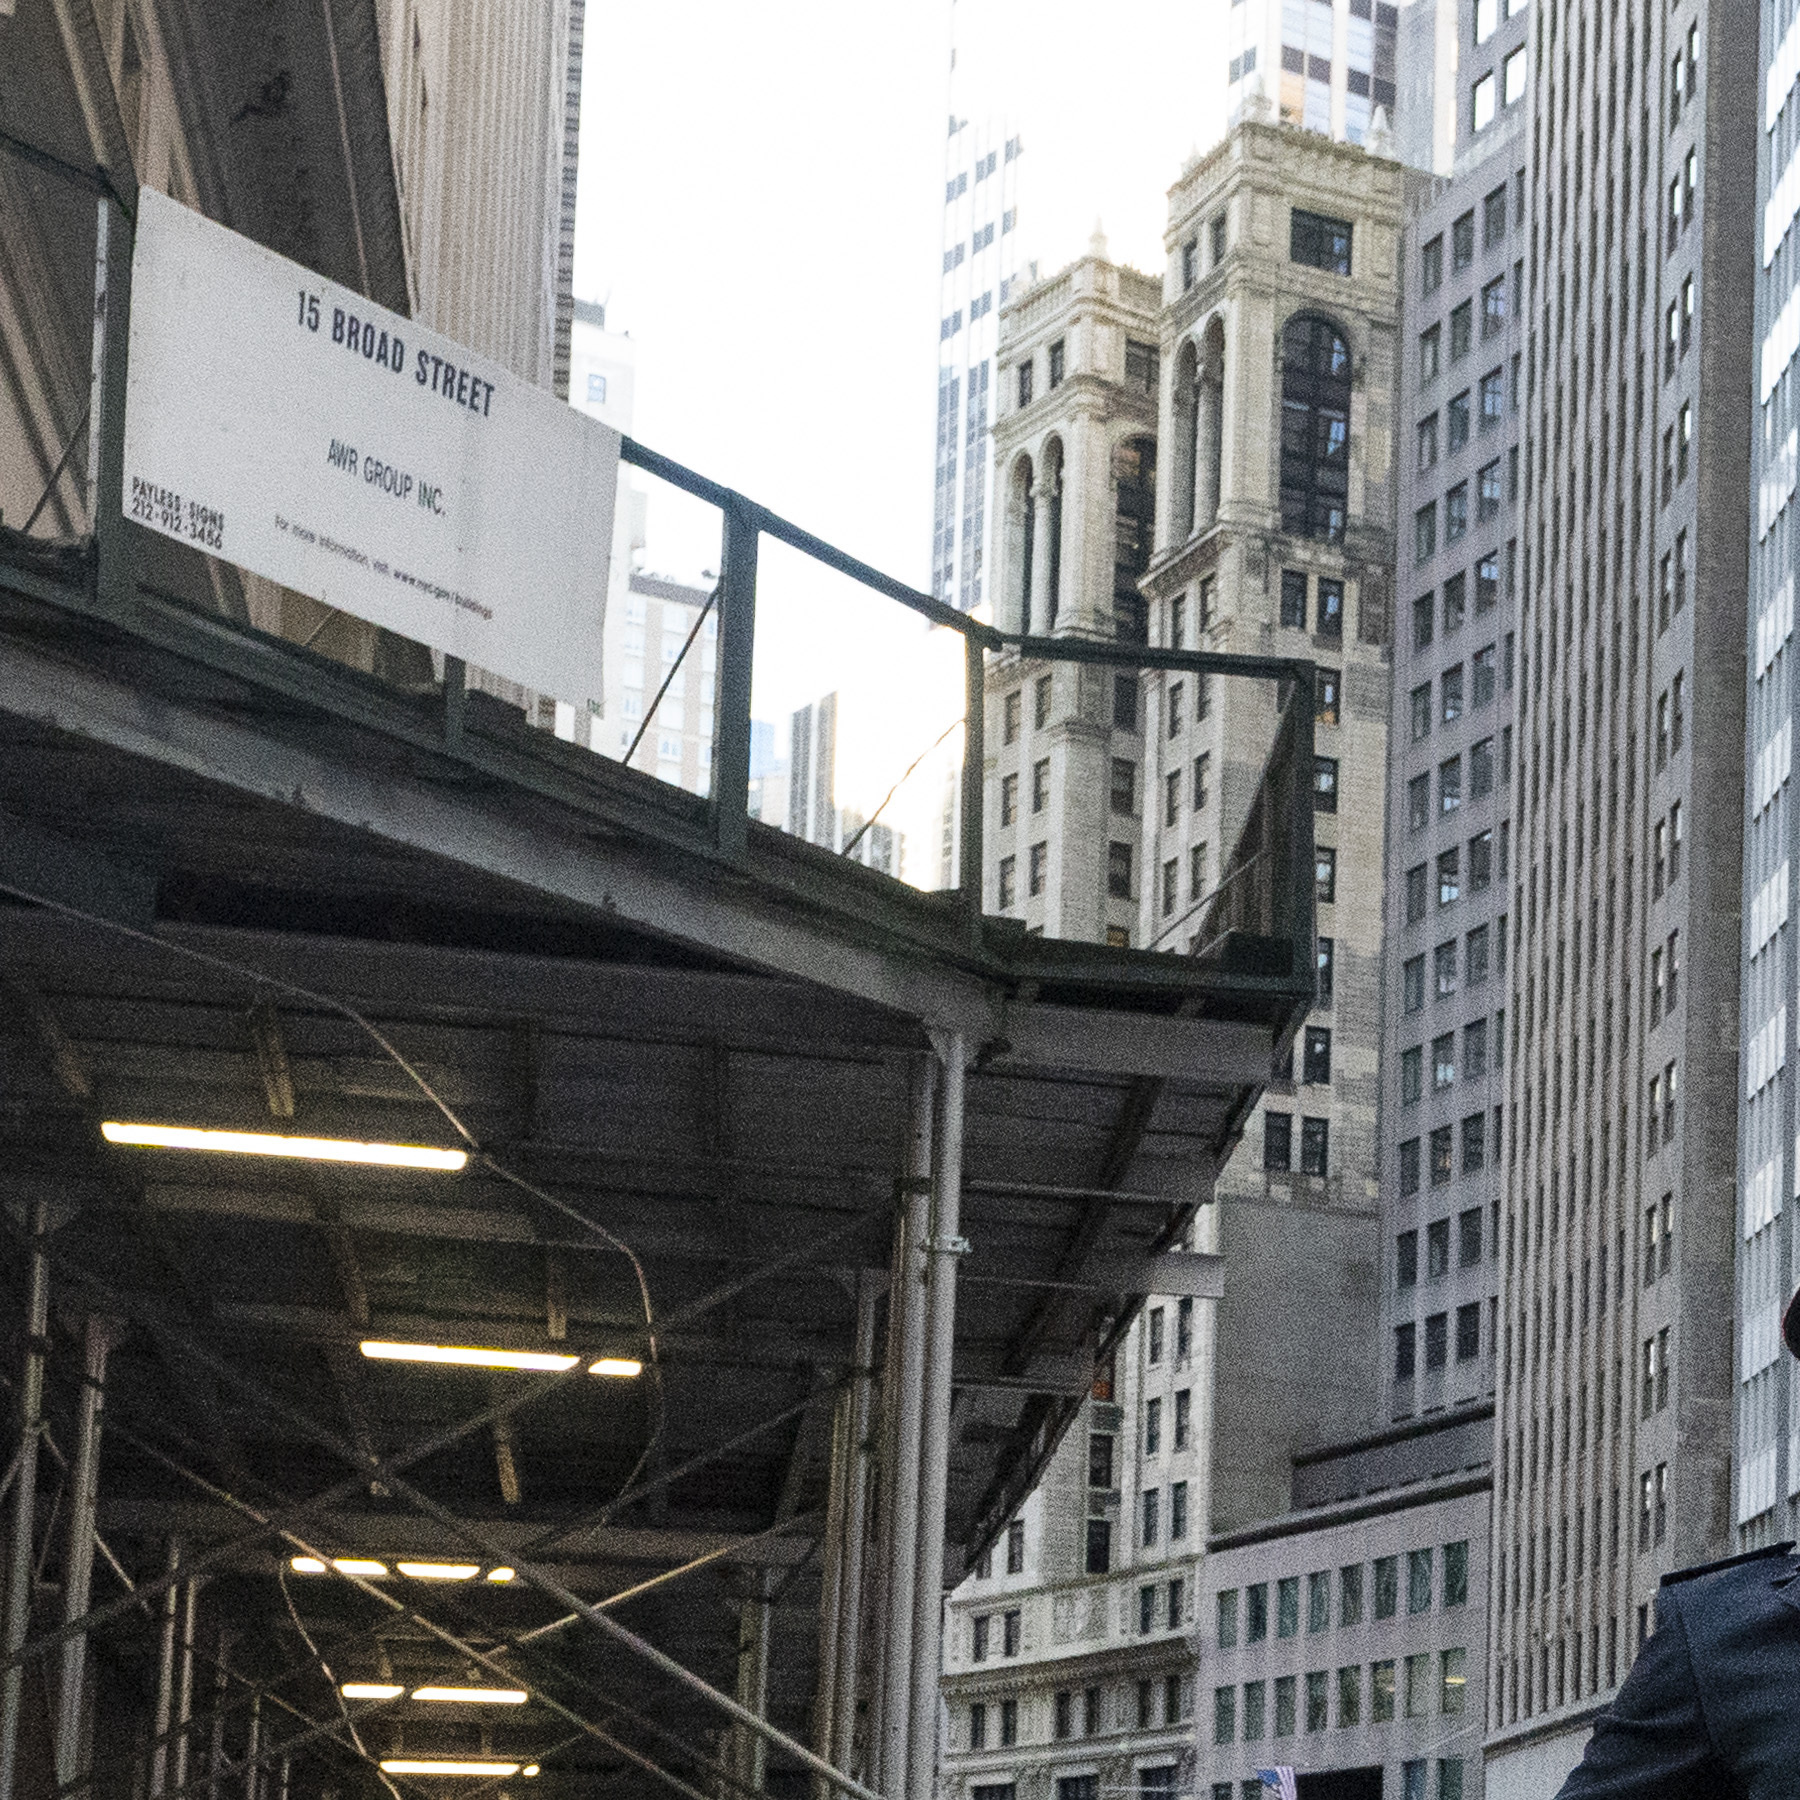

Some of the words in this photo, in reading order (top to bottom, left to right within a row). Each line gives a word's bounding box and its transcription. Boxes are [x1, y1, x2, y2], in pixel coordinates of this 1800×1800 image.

[298, 289, 321, 333] 15
[331, 307, 405, 375] BROAD
[415, 349, 496, 418] STREET
[132, 475, 180, 513] PAYLESS
[326, 438, 359, 477] AWR
[363, 455, 414, 500] GROUP
[417, 479, 446, 516] INC.
